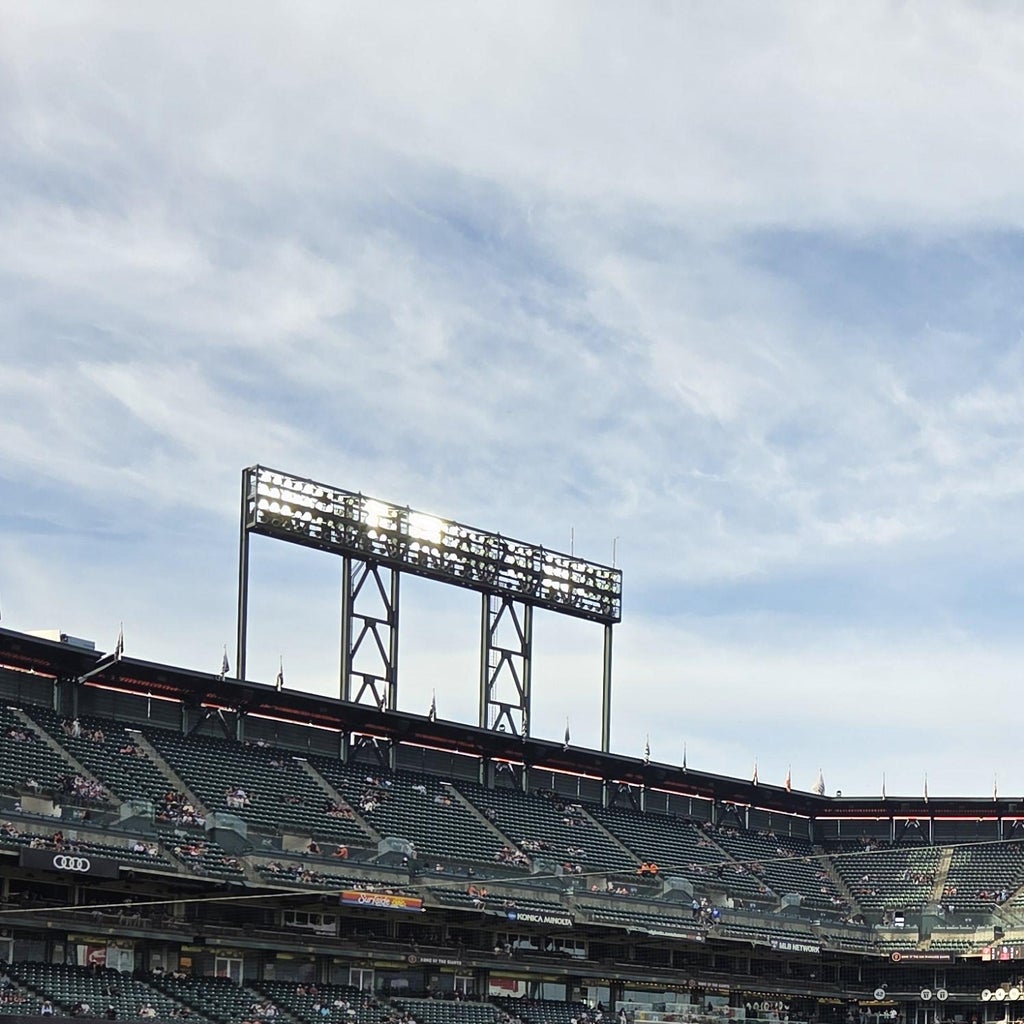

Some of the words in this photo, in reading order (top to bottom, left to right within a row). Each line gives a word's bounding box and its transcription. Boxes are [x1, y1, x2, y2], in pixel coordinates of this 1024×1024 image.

[517, 913, 543, 922] KONICA
[544, 916, 572, 926] MINOLTA
[779, 942, 791, 950] MLB
[793, 944, 820, 953] NETWORK
